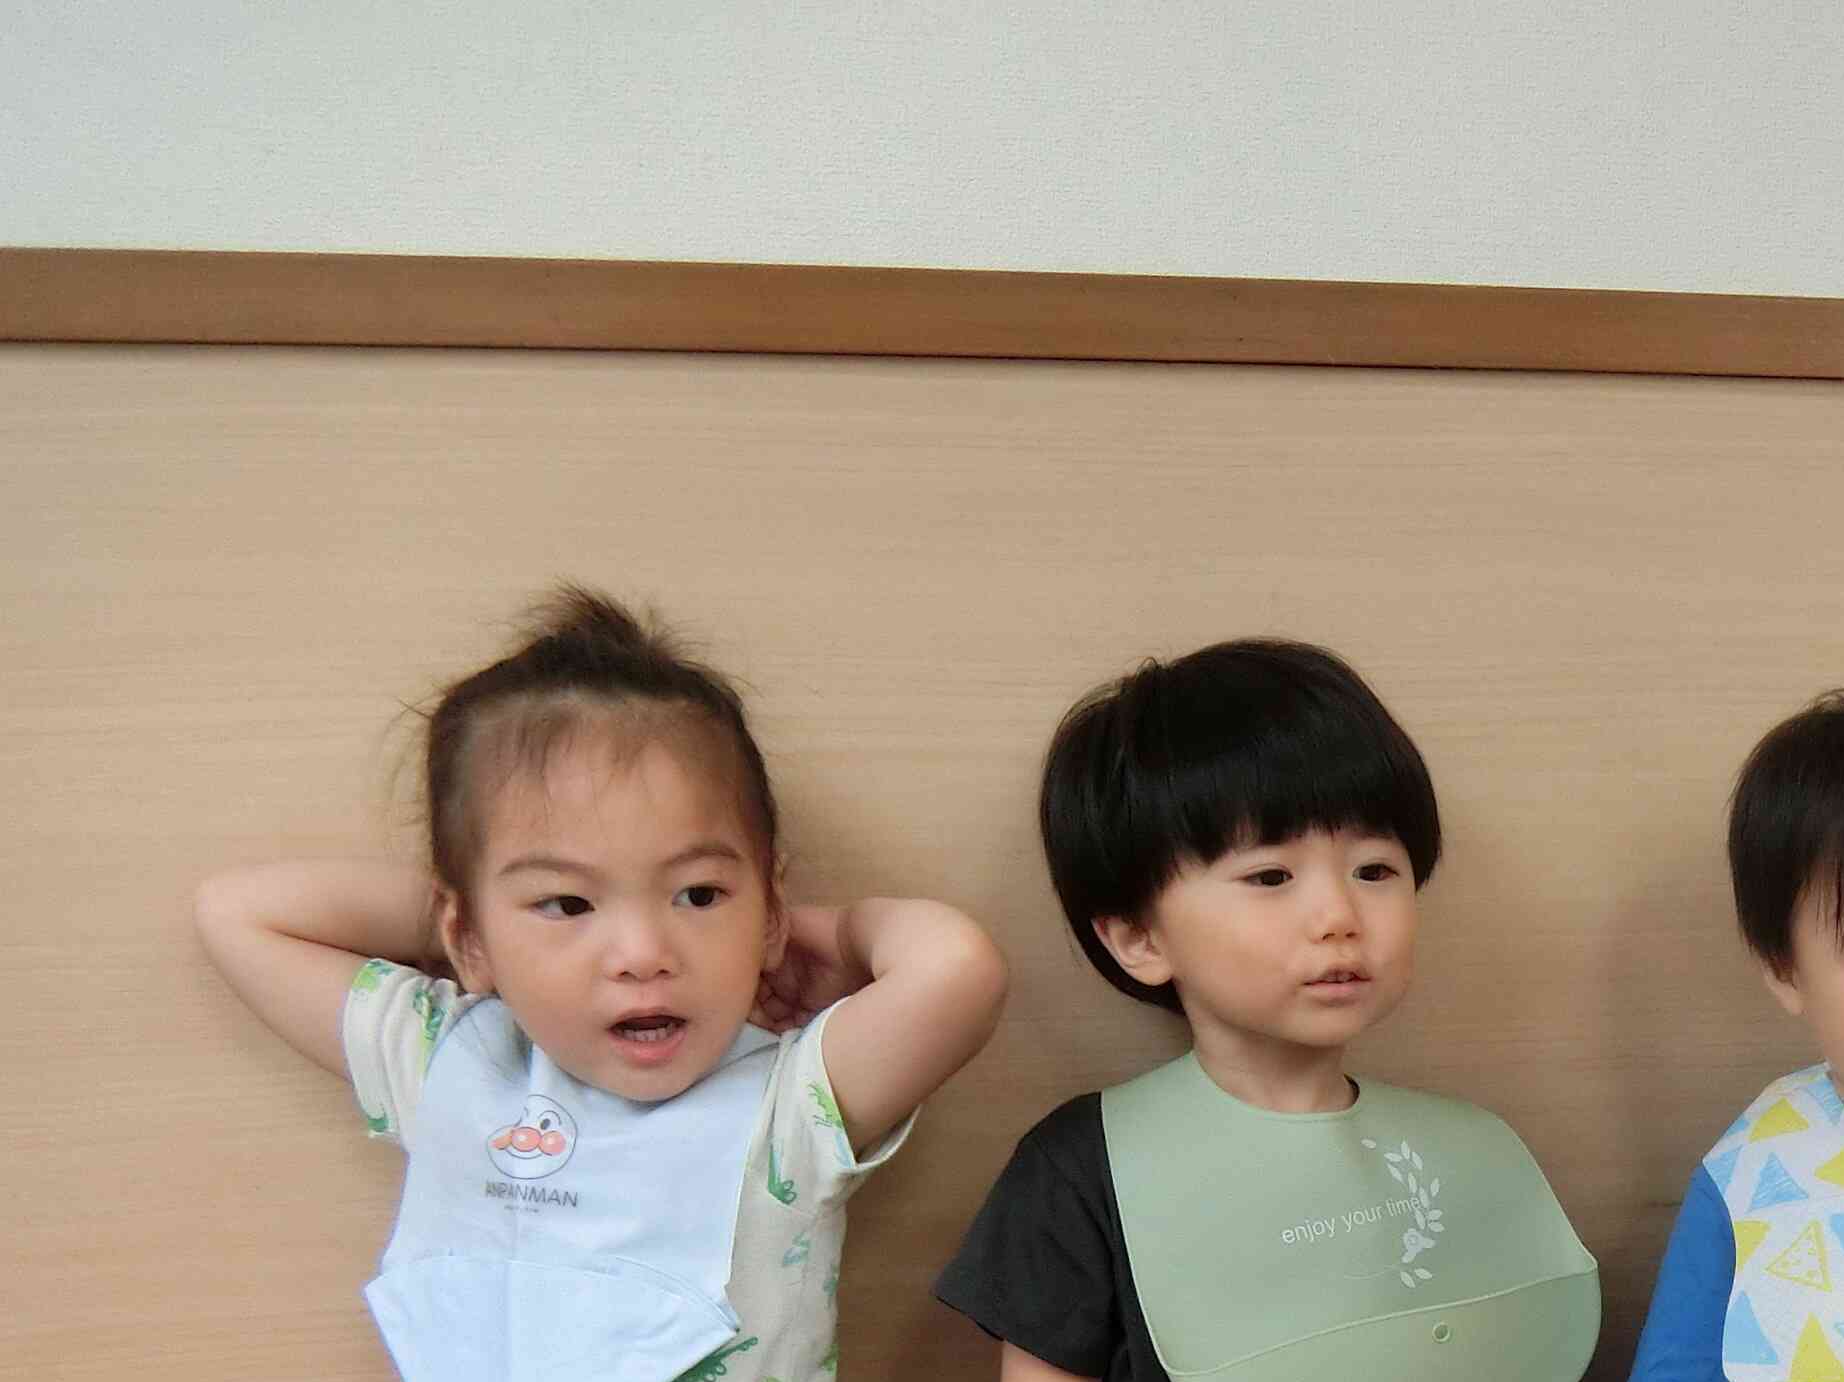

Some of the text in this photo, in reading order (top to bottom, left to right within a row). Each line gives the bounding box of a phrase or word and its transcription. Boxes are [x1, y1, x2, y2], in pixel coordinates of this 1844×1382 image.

[1281, 1196, 1422, 1245] enjoy your time
